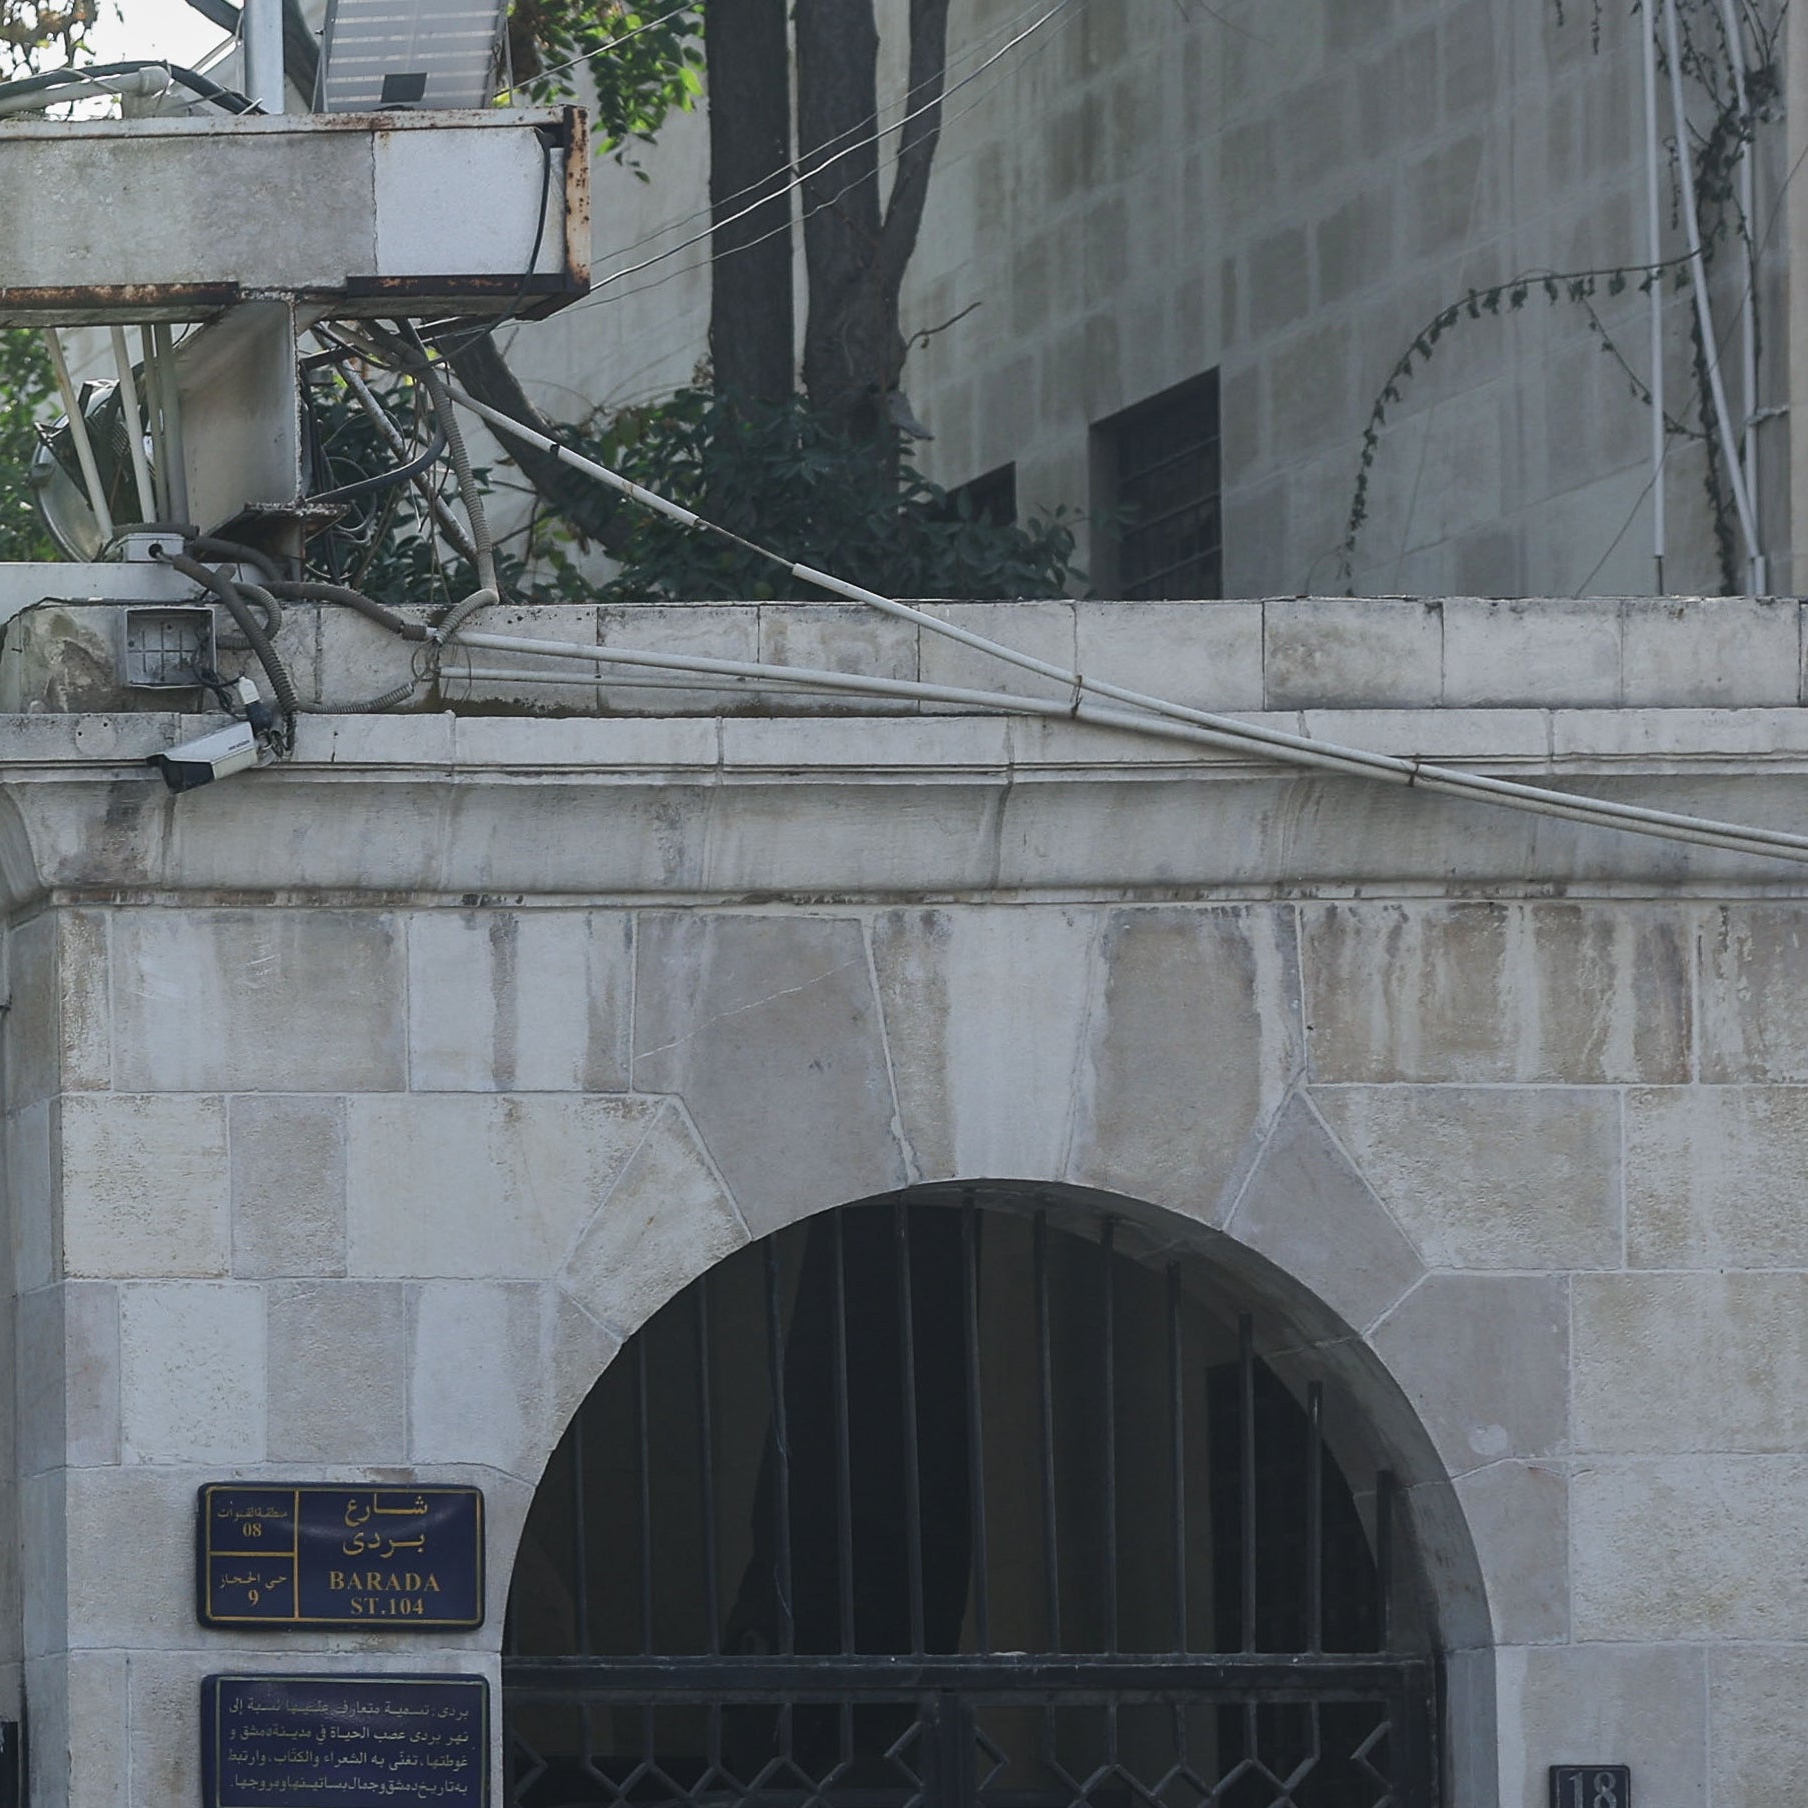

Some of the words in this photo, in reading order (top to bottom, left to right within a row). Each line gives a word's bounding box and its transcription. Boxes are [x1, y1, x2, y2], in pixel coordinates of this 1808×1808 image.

[344, 1492, 429, 1527] شارع
[242, 1522, 263, 1537] 08
[342, 1531, 427, 1559] بردى
[328, 1570, 442, 1592] BARADA
[248, 1589, 260, 1606] 9
[350, 1597, 425, 1616] ST.104
